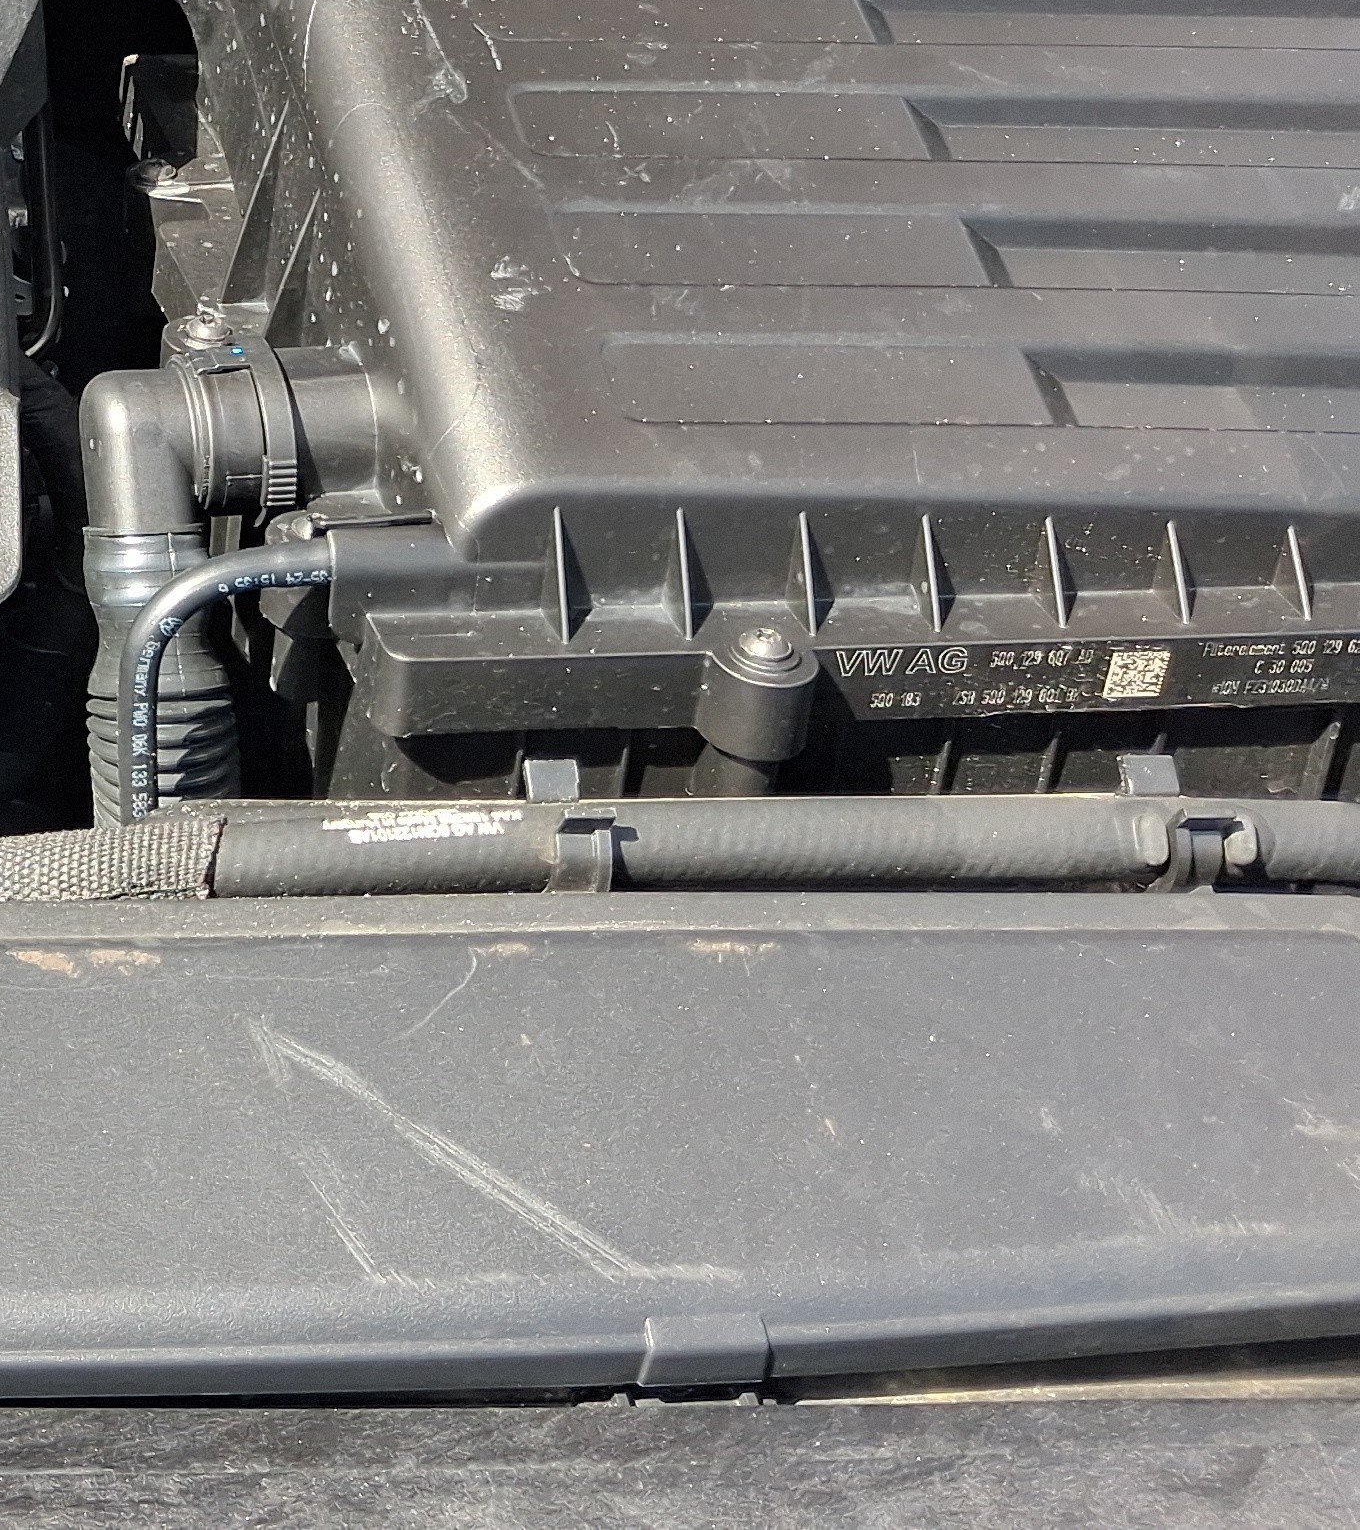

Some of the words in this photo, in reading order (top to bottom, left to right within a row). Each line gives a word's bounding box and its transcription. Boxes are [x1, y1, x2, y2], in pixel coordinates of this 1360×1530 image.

[1322, 639, 1343, 654] 129
[835, 648, 904, 677] VW
[905, 647, 969, 675] AG
[1021, 650, 1044, 666] 129
[1254, 660, 1264, 674] C
[1012, 688, 1033, 704] 129
[132, 764, 148, 787] 133
